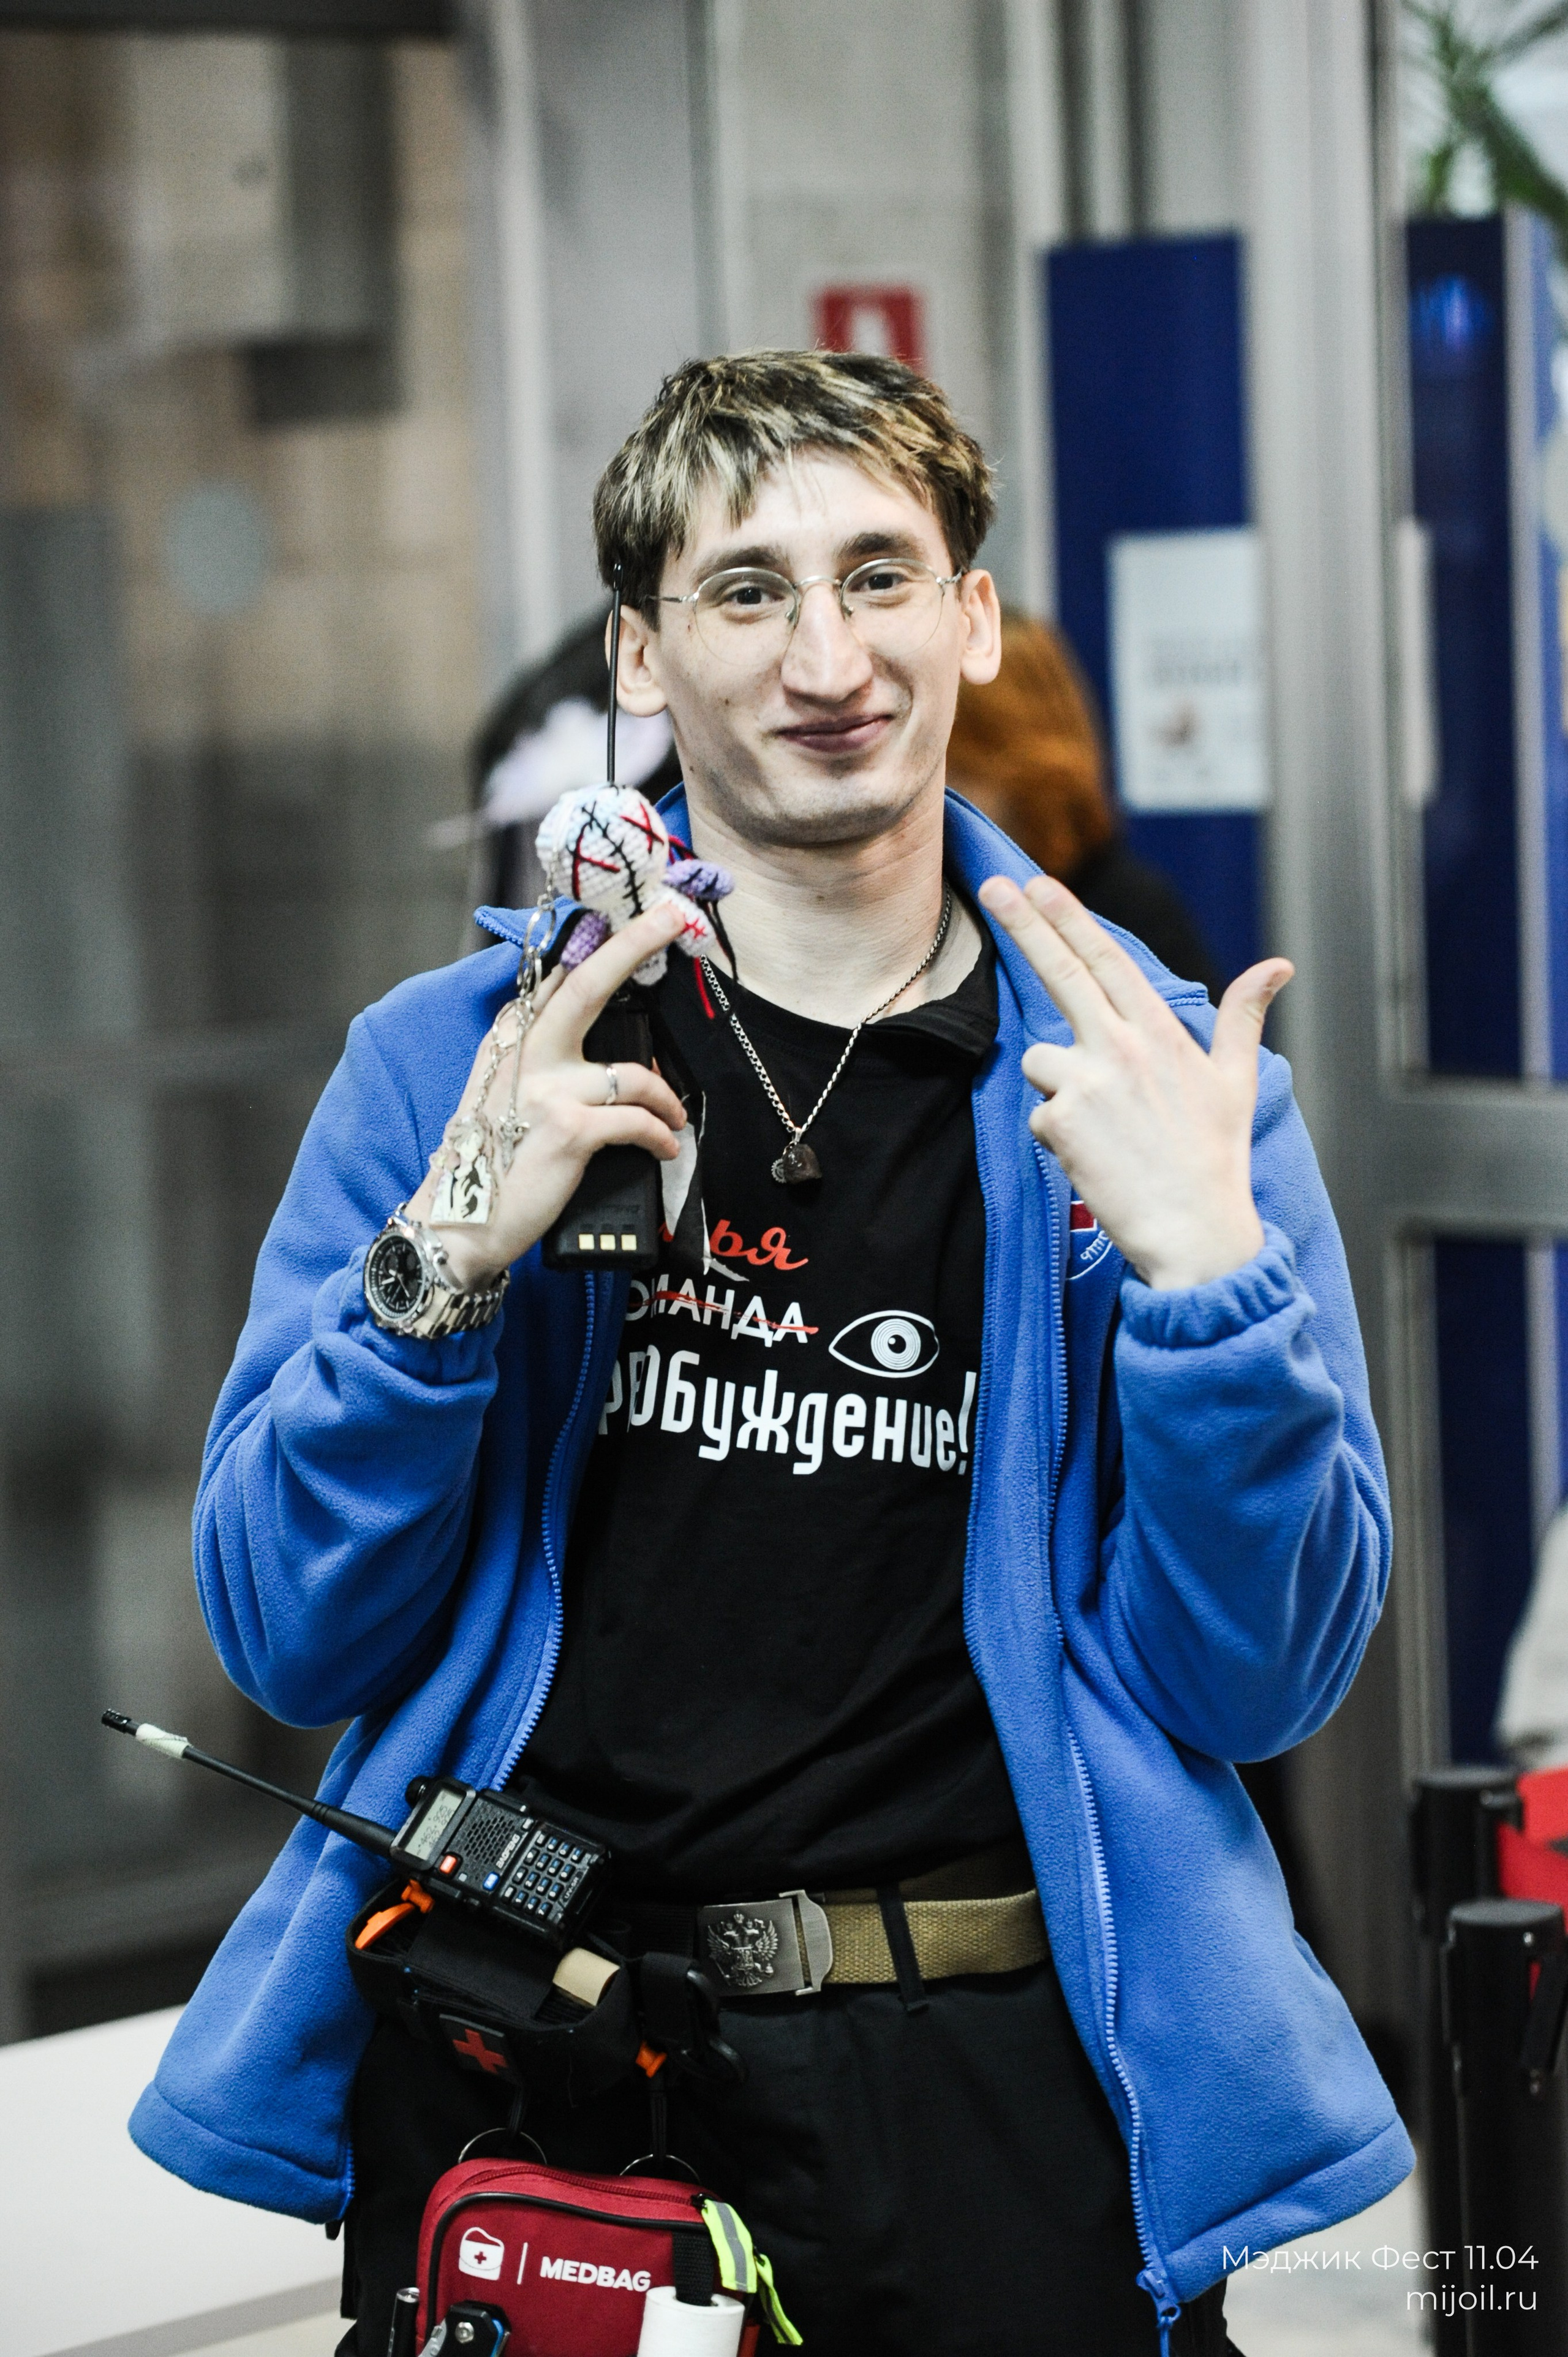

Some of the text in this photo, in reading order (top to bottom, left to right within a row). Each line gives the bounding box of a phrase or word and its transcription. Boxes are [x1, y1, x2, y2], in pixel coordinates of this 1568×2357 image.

[709, 1219, 809, 1270] ья
[625, 1274, 809, 1347] ОАНДА
[496, 1834, 520, 1869] BAOFENG
[540, 2256, 651, 2292] MEDBAG
